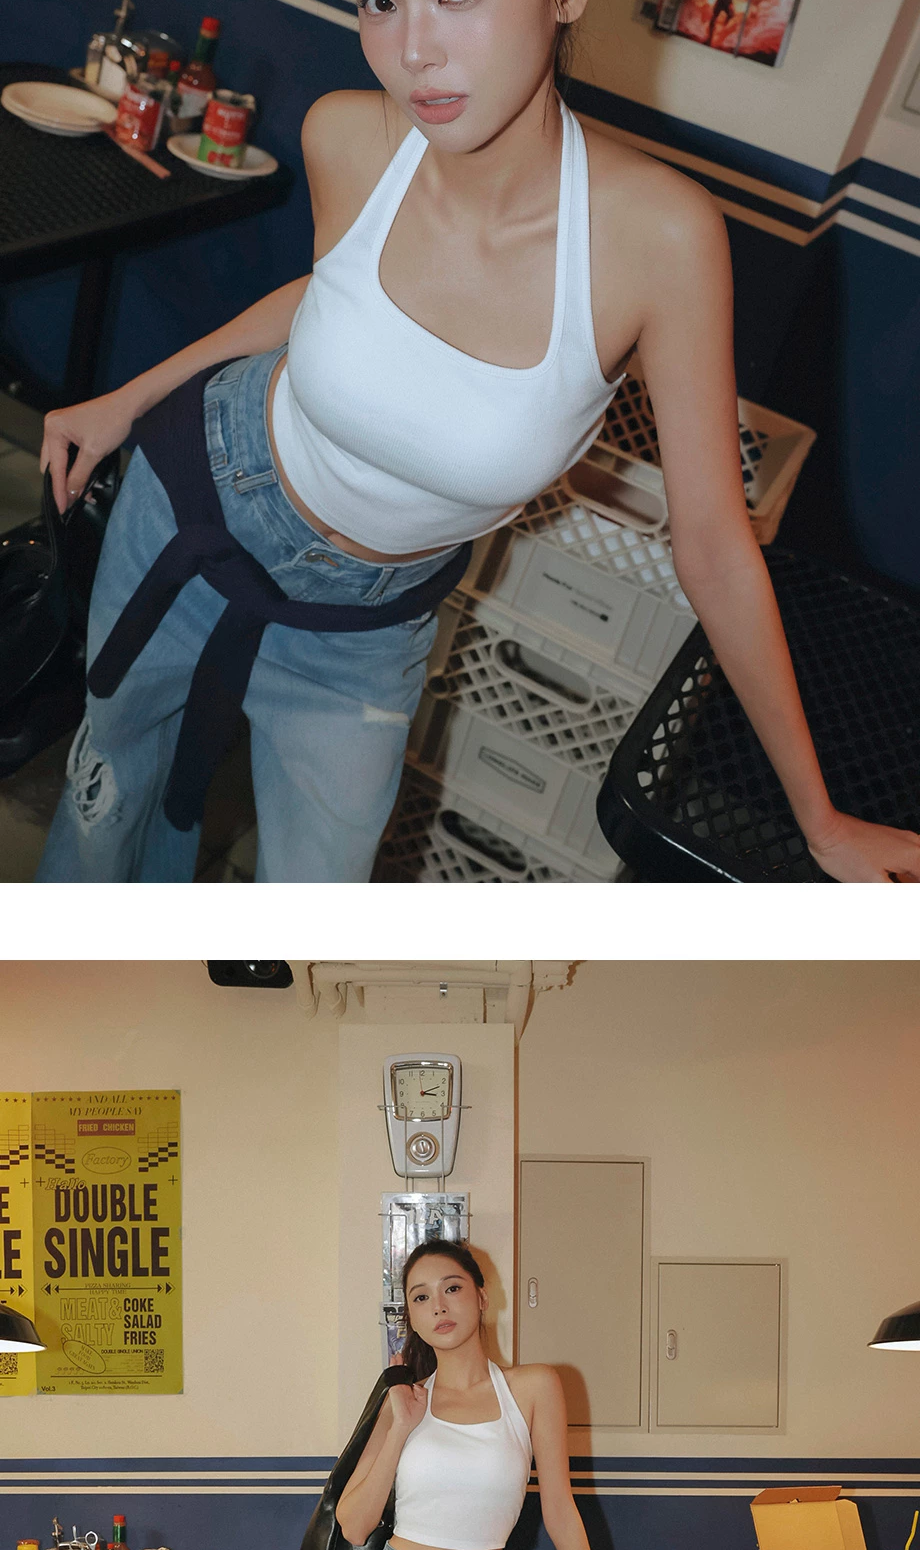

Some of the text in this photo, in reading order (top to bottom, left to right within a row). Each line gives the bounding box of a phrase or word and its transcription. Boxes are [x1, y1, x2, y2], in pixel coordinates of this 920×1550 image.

[84, 1108, 124, 1116] PEOPLE
[78, 1122, 135, 1132] FRIED CHICKEN
[85, 1153, 129, 1171] Factory
[54, 1183, 158, 1223] DOUBLE
[44, 1226, 170, 1279] SINGLE
[60, 1297, 122, 1320] MEAT&
[123, 1298, 154, 1312] COKE
[123, 1314, 162, 1328] SALAD
[60, 1323, 114, 1346] SALTY
[123, 1331, 157, 1345] FRIES
